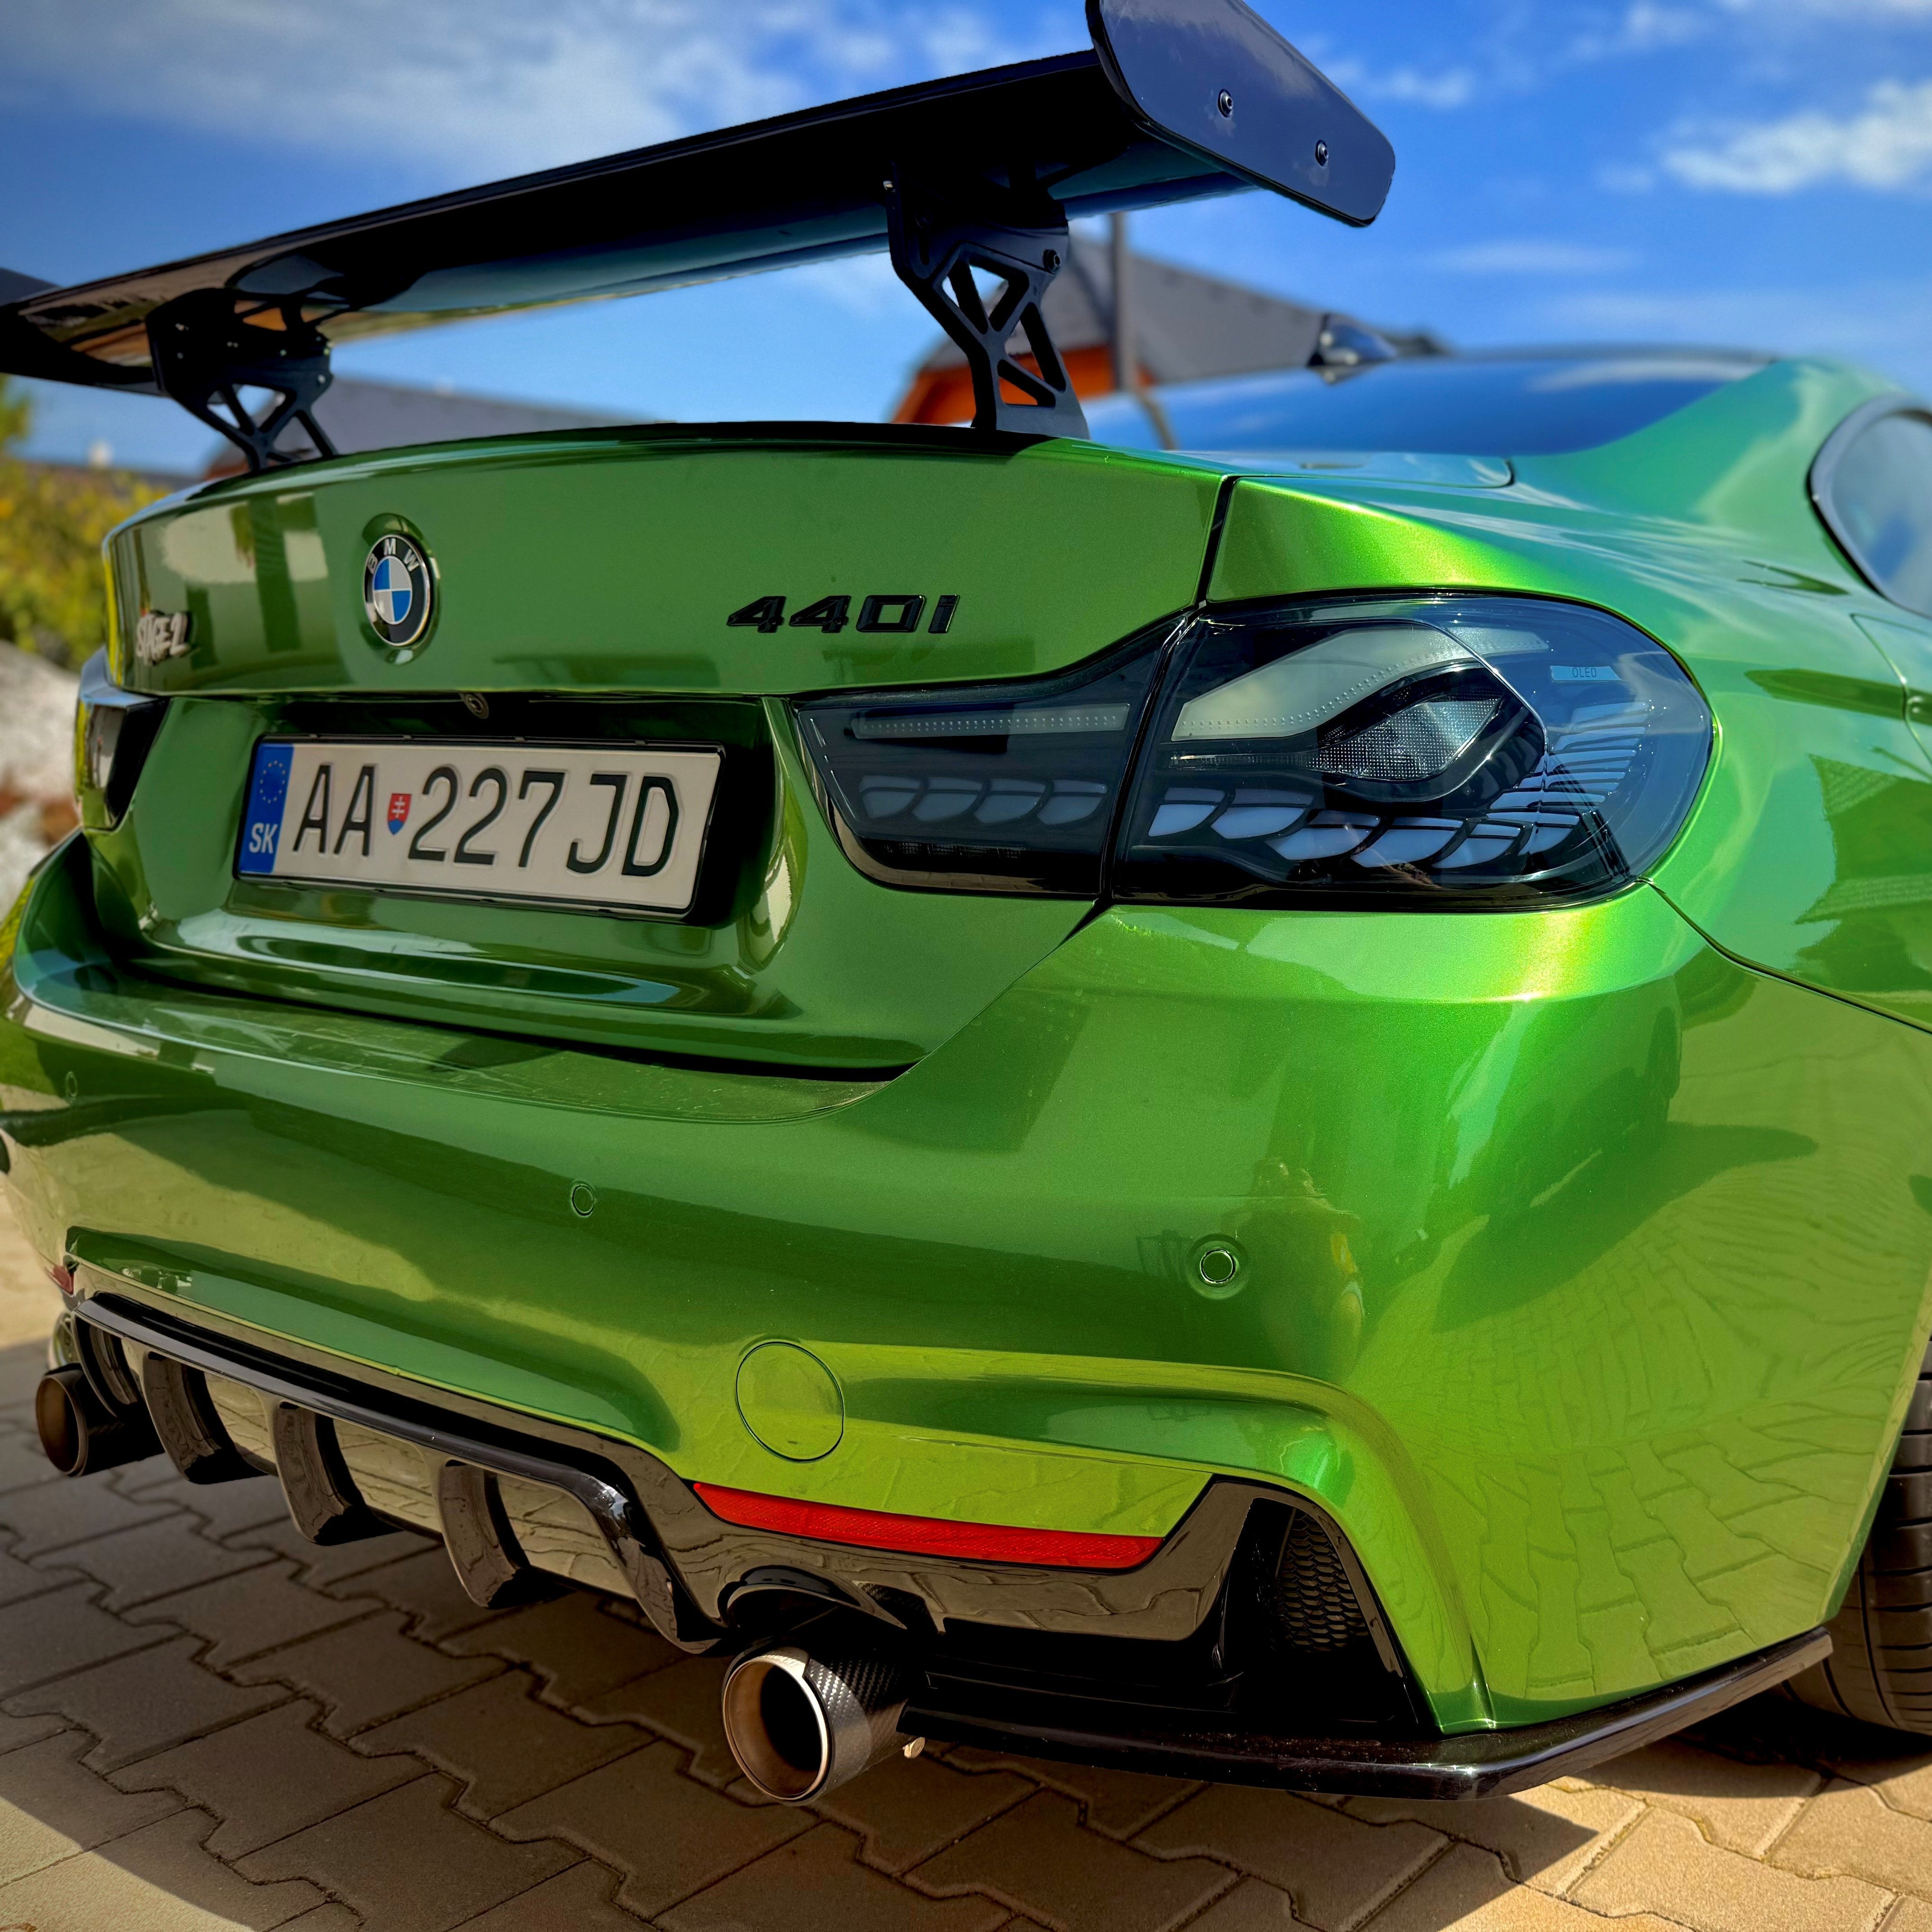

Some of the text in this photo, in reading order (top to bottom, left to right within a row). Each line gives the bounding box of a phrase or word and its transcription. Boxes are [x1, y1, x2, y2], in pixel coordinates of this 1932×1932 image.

[367, 538, 420, 574] BMW
[1572, 667, 1597, 678] OLED
[292, 764, 375, 856] AA
[249, 822, 278, 854] SK
